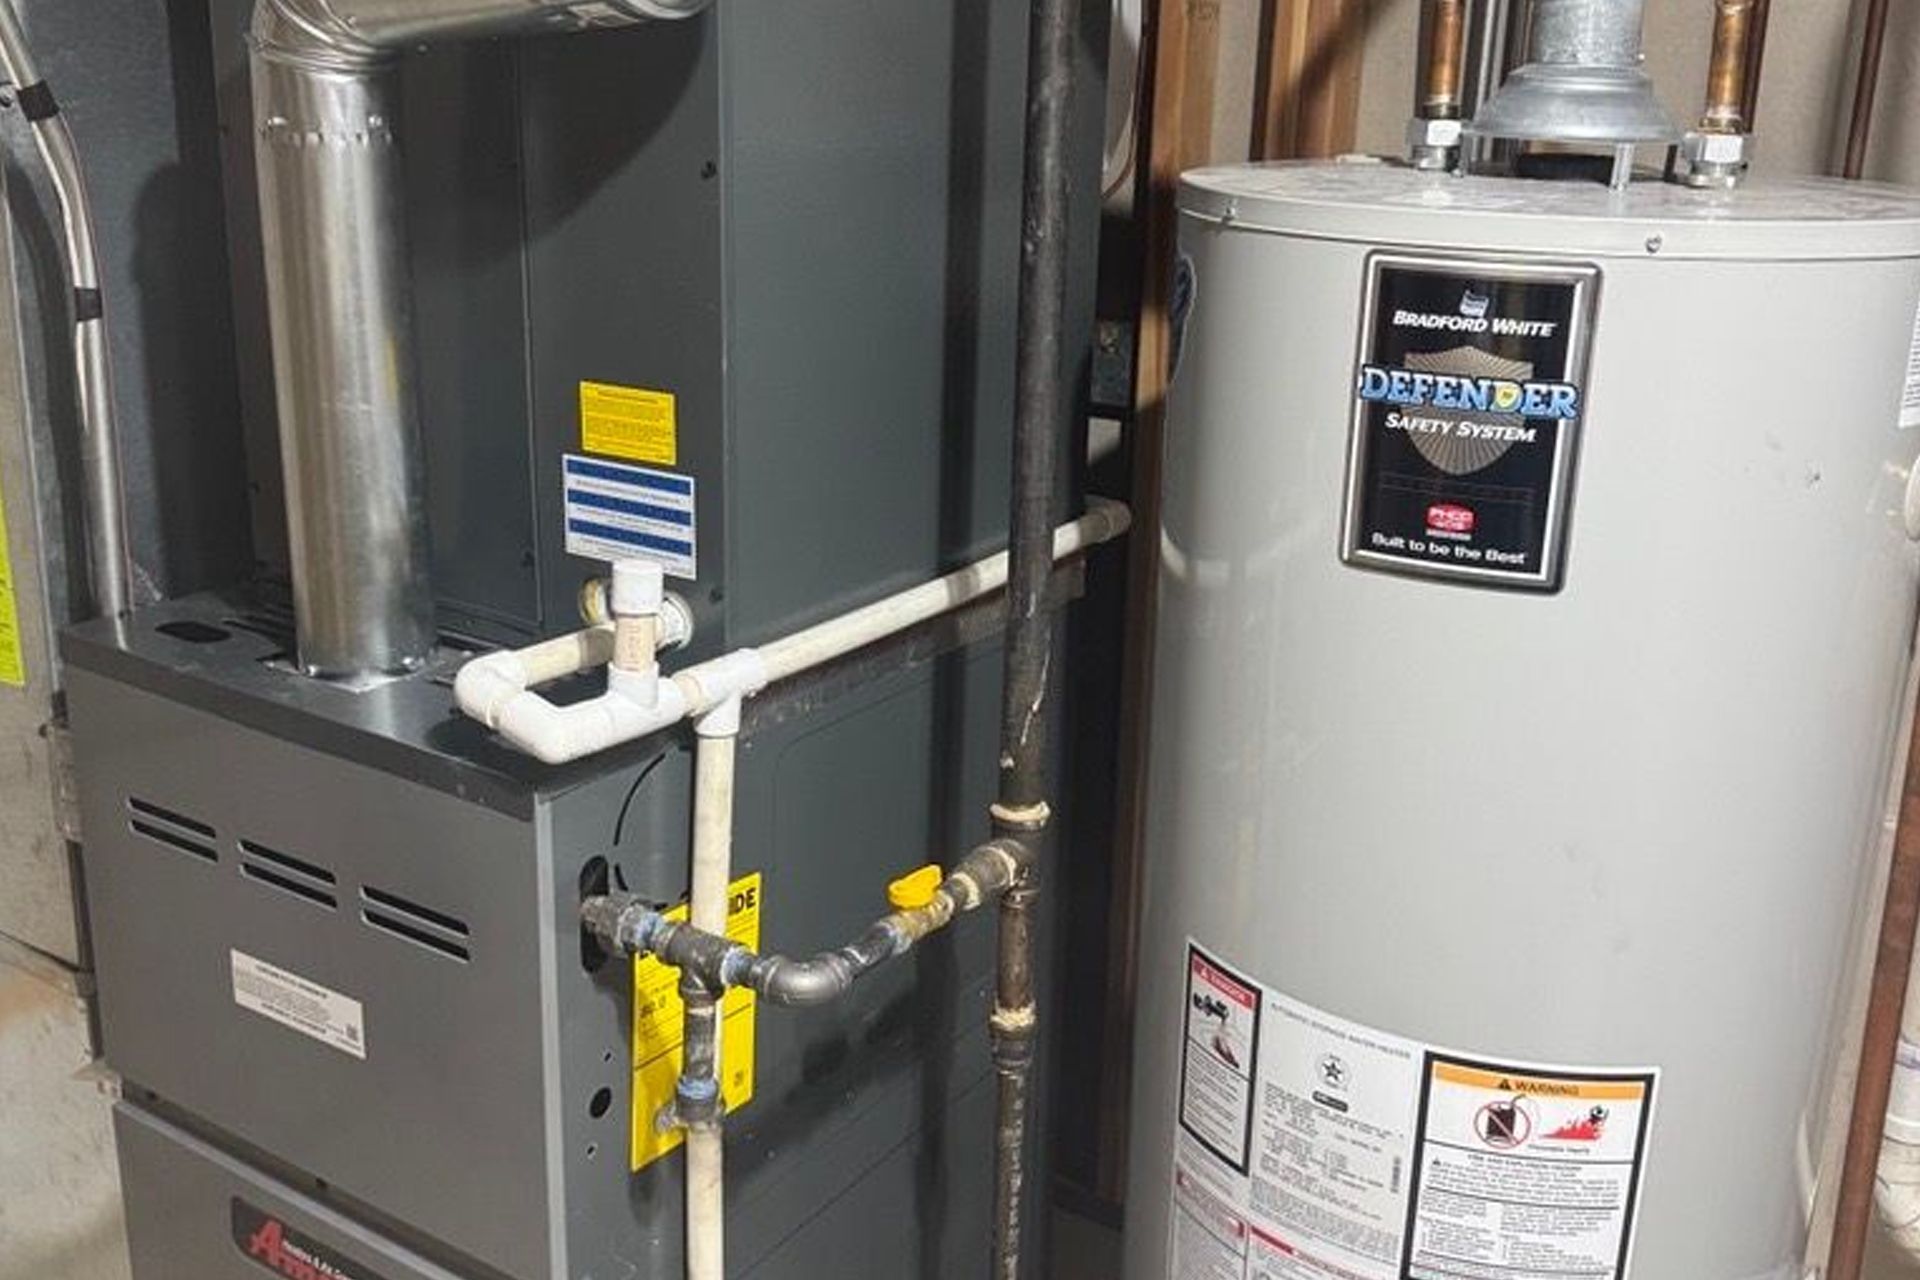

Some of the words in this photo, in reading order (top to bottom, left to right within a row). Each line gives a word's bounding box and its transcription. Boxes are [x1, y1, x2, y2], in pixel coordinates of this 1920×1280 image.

[1393, 310, 1488, 333] BRADFORD
[1491, 317, 1557, 338] WHITE
[1360, 366, 1578, 418] DEFENDER
[1385, 412, 1454, 434] SAFETY
[1456, 421, 1537, 443] SYSTEM
[1371, 531, 1405, 549] Built
[1408, 539, 1425, 551] to
[1428, 542, 1450, 556] be
[1454, 545, 1482, 560] the
[1485, 549, 1526, 565] Best
[1515, 1080, 1580, 1096] WARNING
